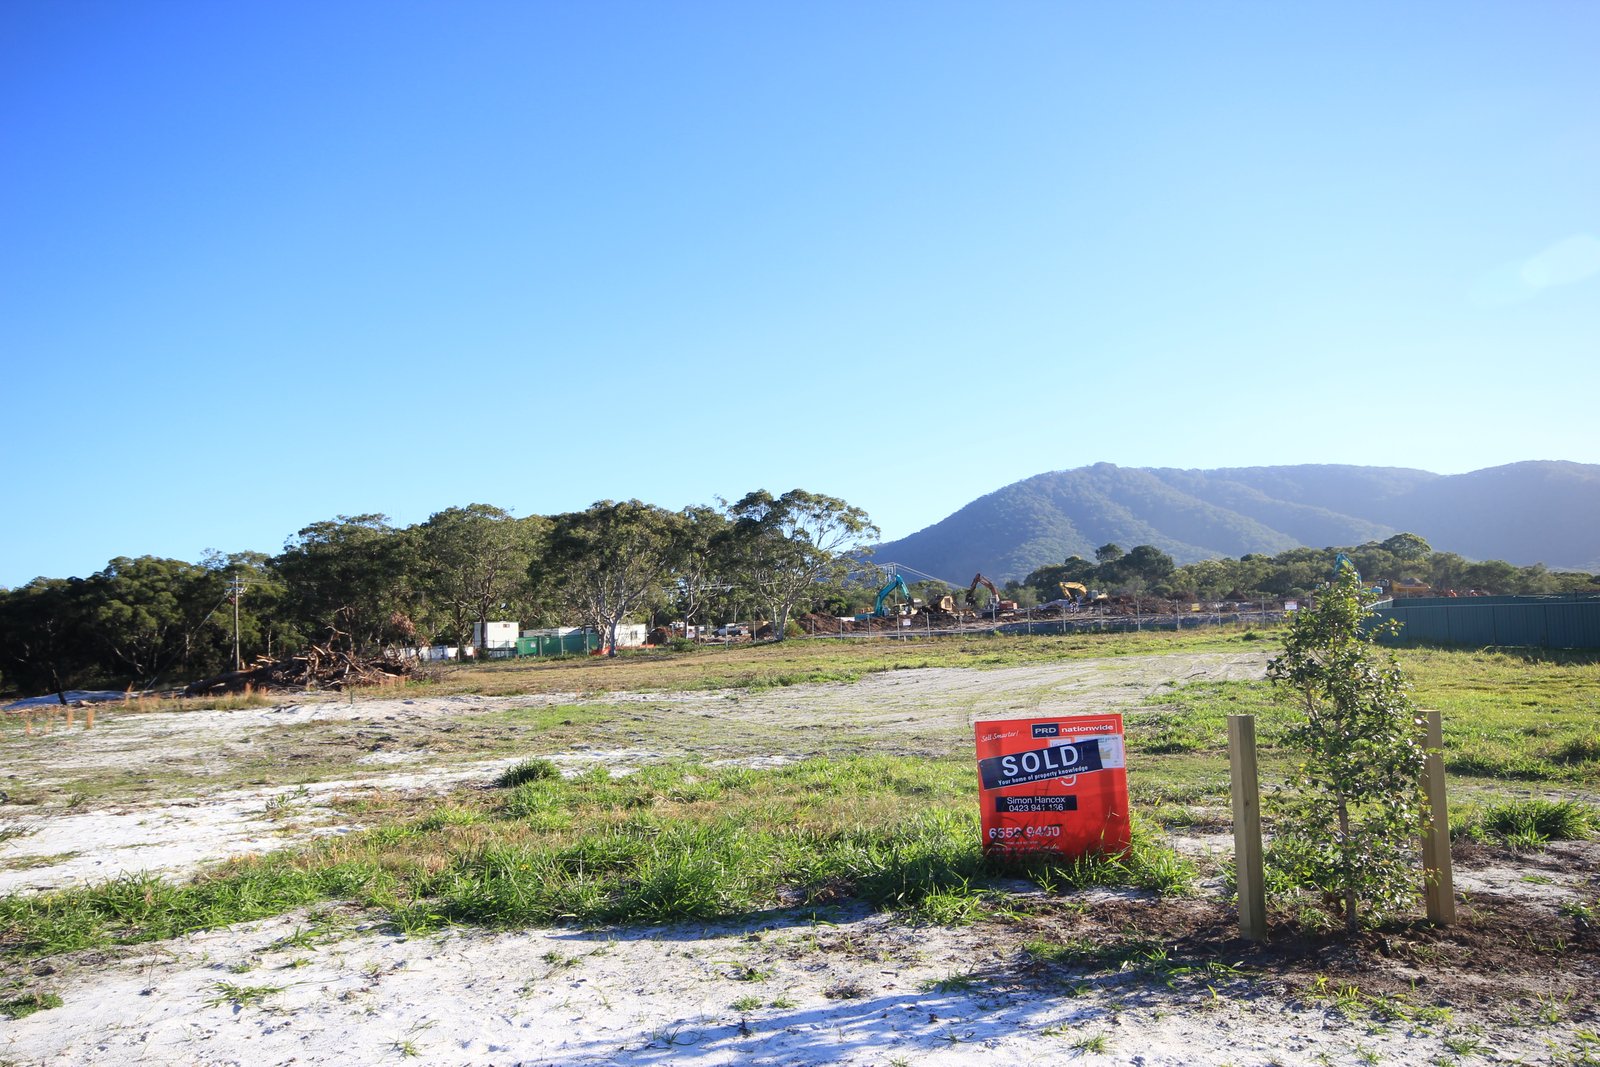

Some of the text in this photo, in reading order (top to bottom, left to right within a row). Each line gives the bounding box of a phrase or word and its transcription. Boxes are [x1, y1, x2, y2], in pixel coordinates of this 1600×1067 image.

[1061, 724, 1114, 733] nationwide
[981, 730, 1019, 742] Sell Smarter!
[1001, 745, 1079, 777] SOLD
[1034, 771, 1057, 780] property
[1058, 765, 1088, 775] knowledge
[1006, 796, 1066, 805] Simon Hancox
[1008, 804, 1029, 812] 0423
